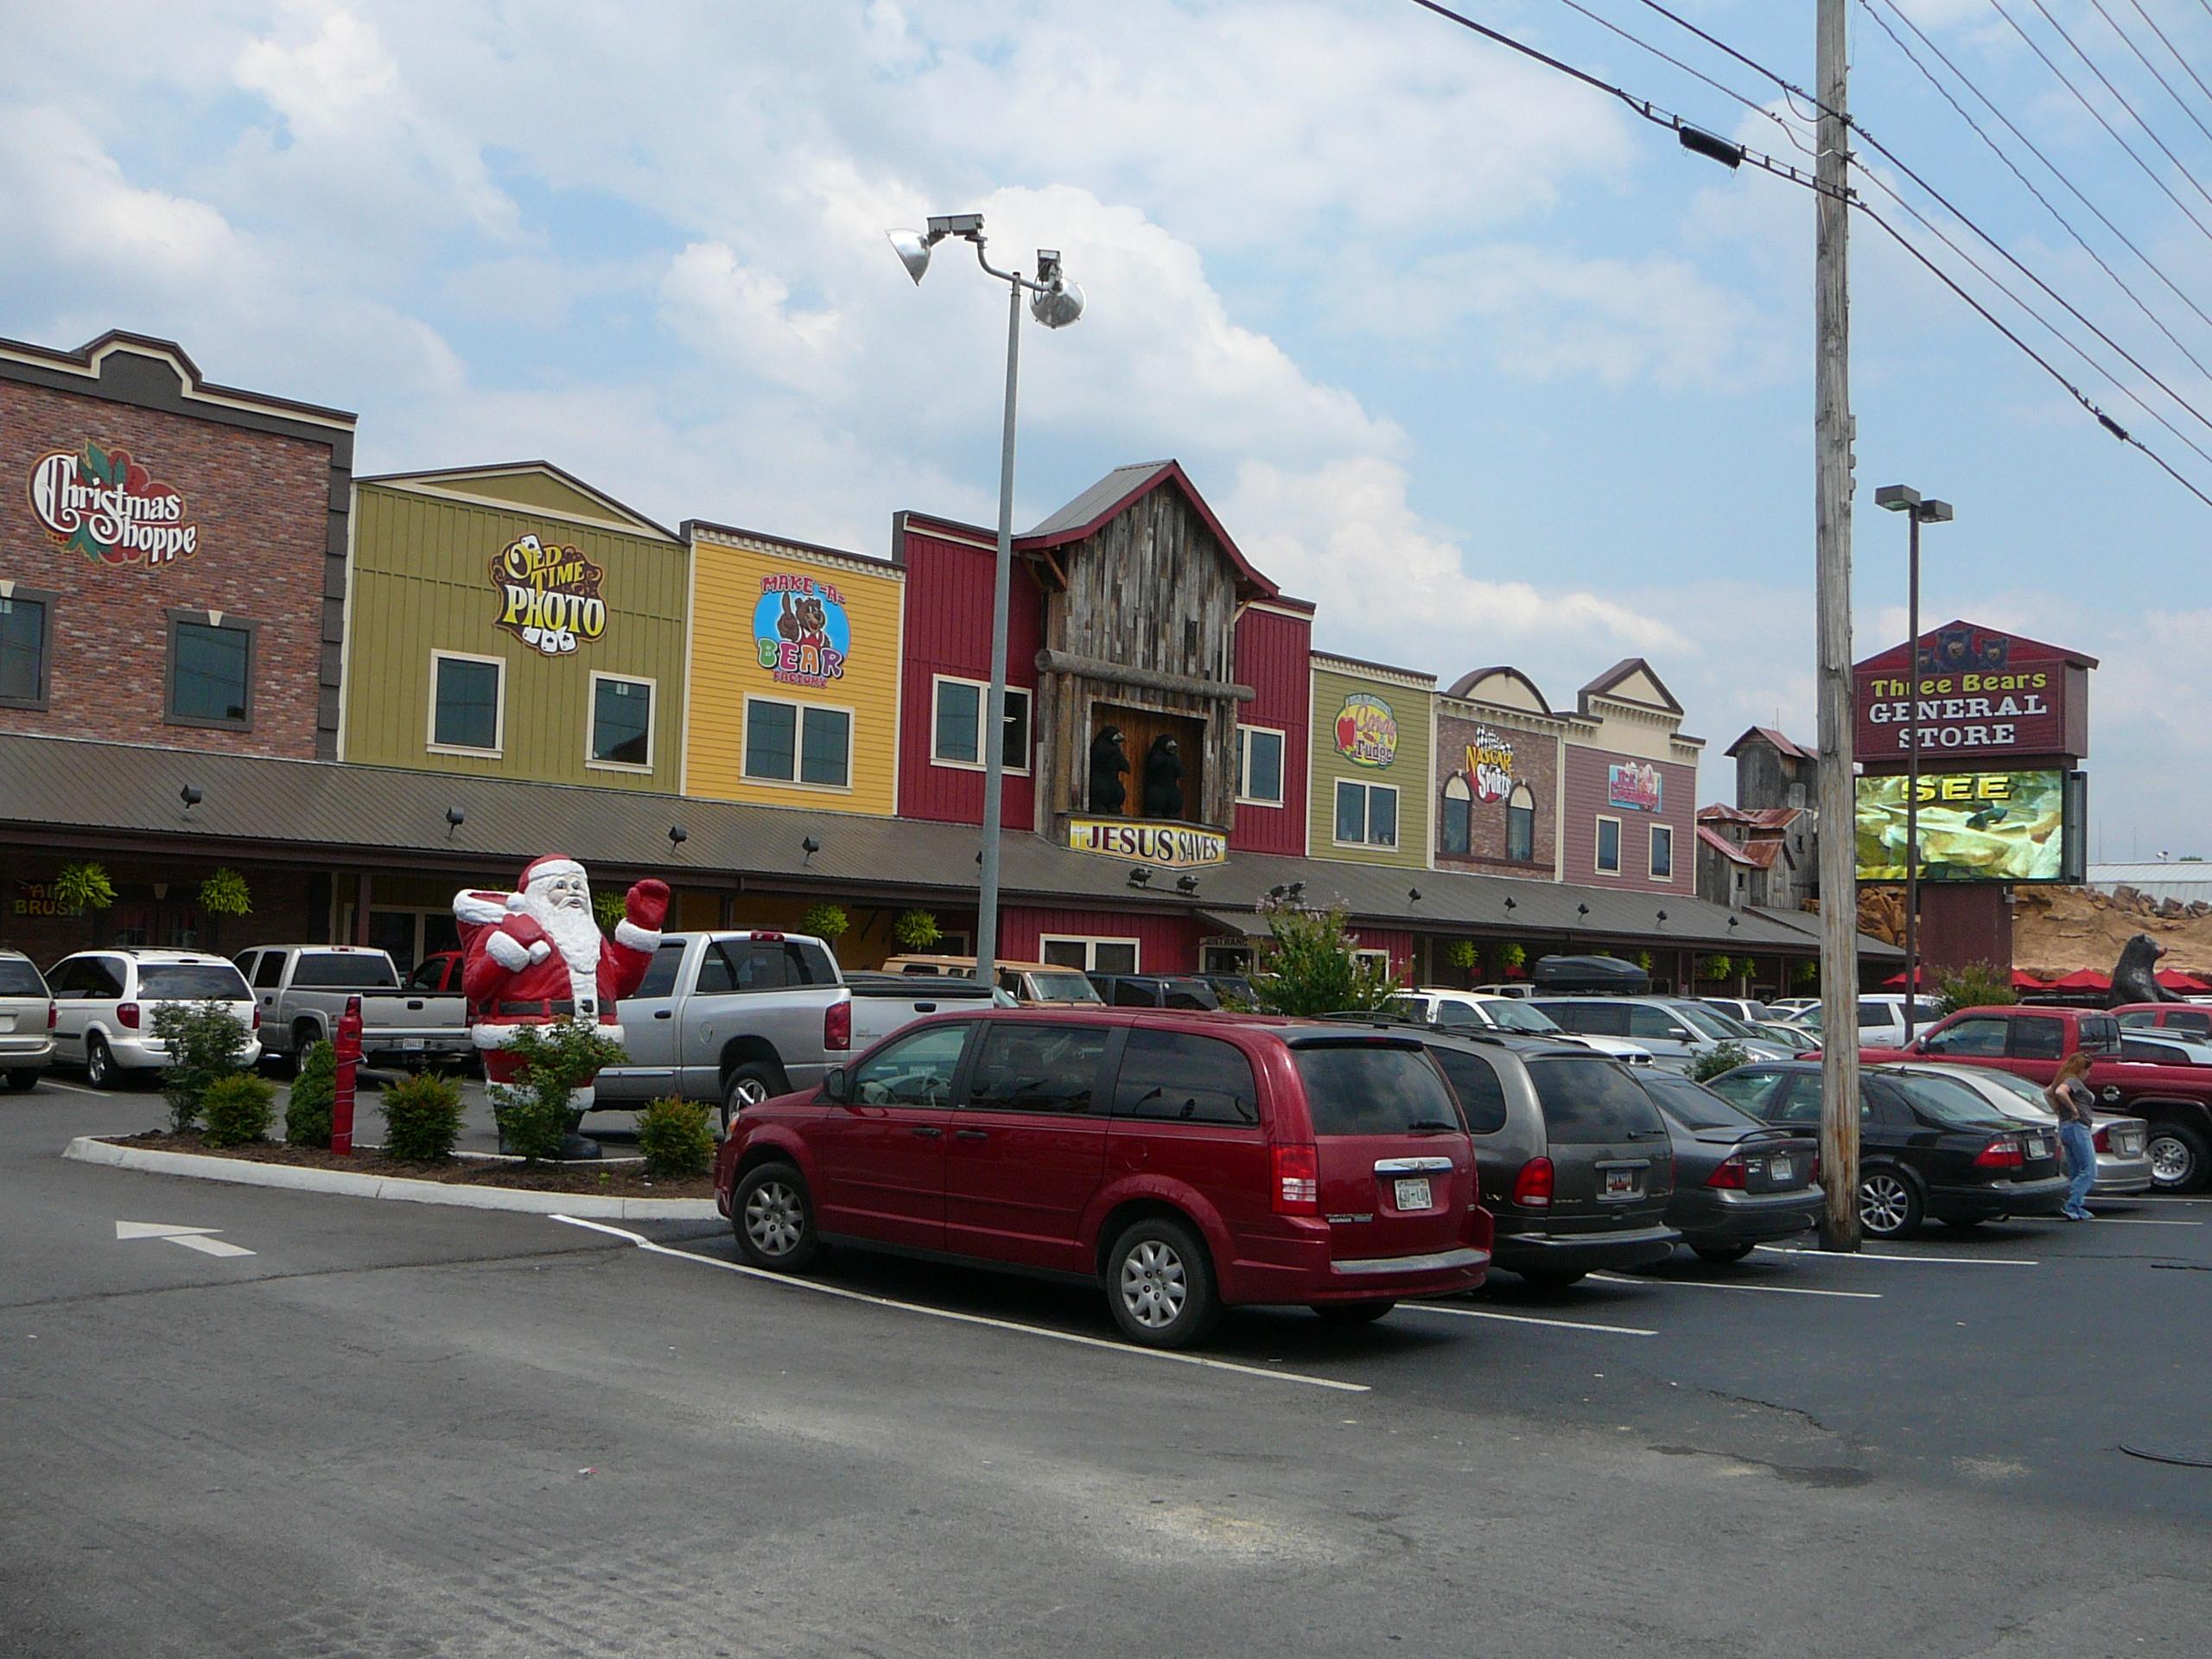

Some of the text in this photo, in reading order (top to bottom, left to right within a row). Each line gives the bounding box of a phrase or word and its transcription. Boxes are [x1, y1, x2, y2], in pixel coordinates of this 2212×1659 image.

[34, 454, 182, 533] Christmas
[89, 492, 197, 563] Shoppe
[505, 543, 563, 579] OLD
[530, 561, 586, 598] TIME
[761, 575, 815, 594] MAKE
[502, 584, 606, 637] PHOTO
[758, 638, 843, 678] BEAR
[773, 671, 828, 689] FACTORY
[1961, 671, 2048, 692] Bears
[1868, 694, 2048, 724] GENERAL
[1357, 740, 1393, 764] Fudge
[1897, 723, 2016, 749] STORE
[1465, 746, 1514, 779] NASCAR
[1901, 776, 2011, 802] SEE
[1086, 825, 1219, 862] JESUS SAVES
